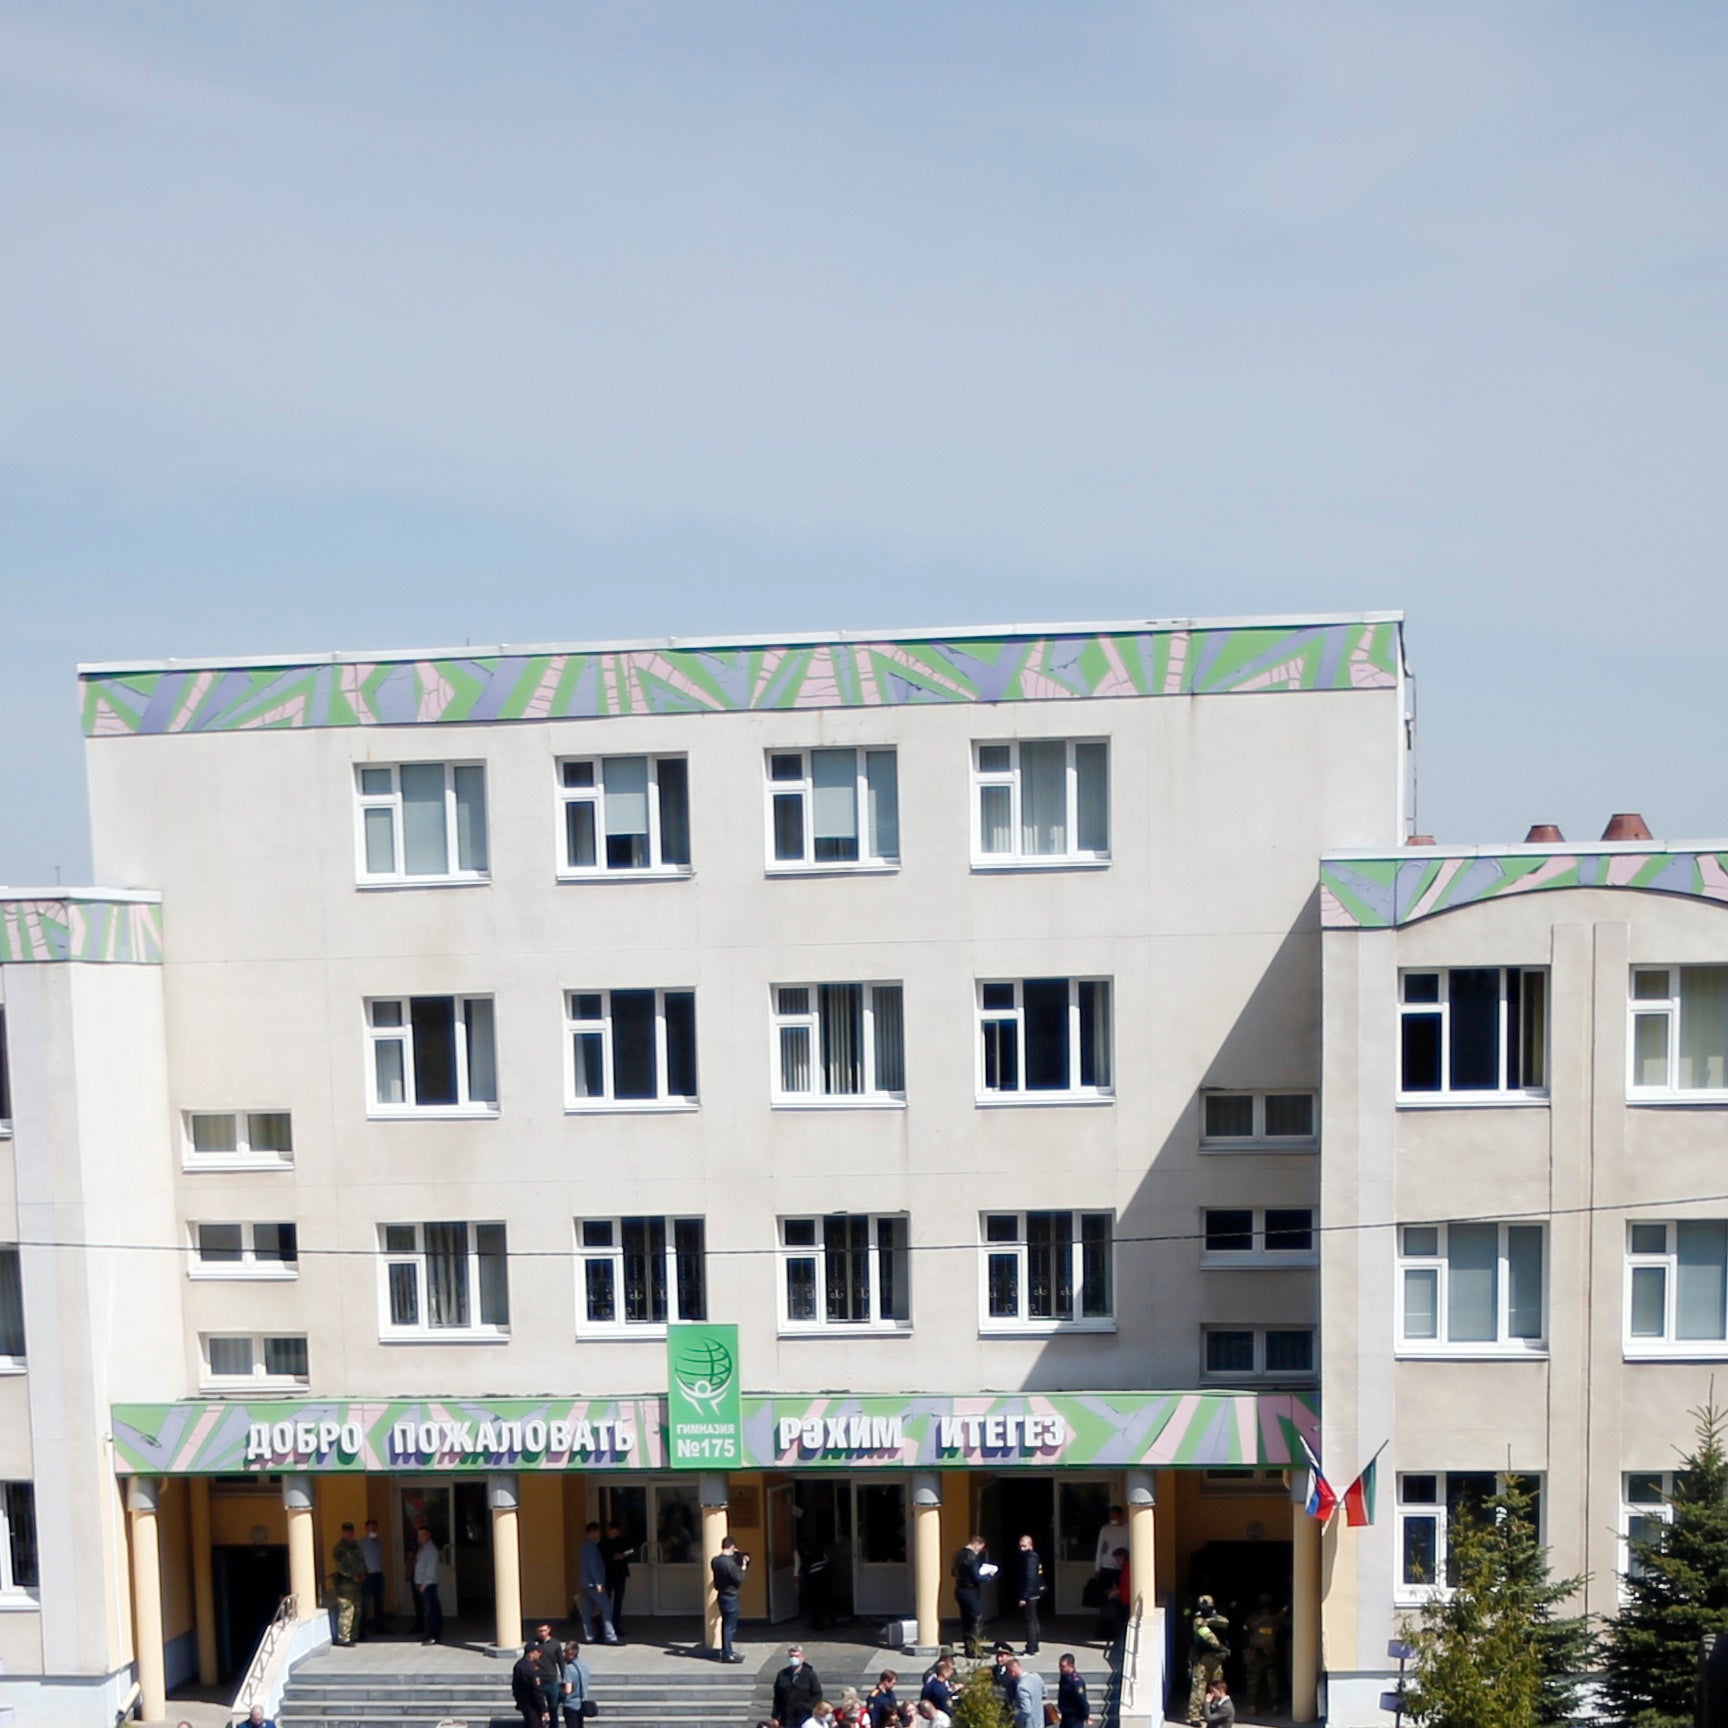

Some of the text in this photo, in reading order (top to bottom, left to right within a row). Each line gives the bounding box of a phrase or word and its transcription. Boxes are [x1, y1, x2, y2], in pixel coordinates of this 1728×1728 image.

[247, 1419, 635, 1460] ДОБРО ПОЖАЛОВАТЬ
[676, 1423, 735, 1435] ГИМНАЗИЯ
[779, 1414, 1065, 1450] РӘХИМ ИТЕГЕЗ
[677, 1438, 736, 1458] №175
